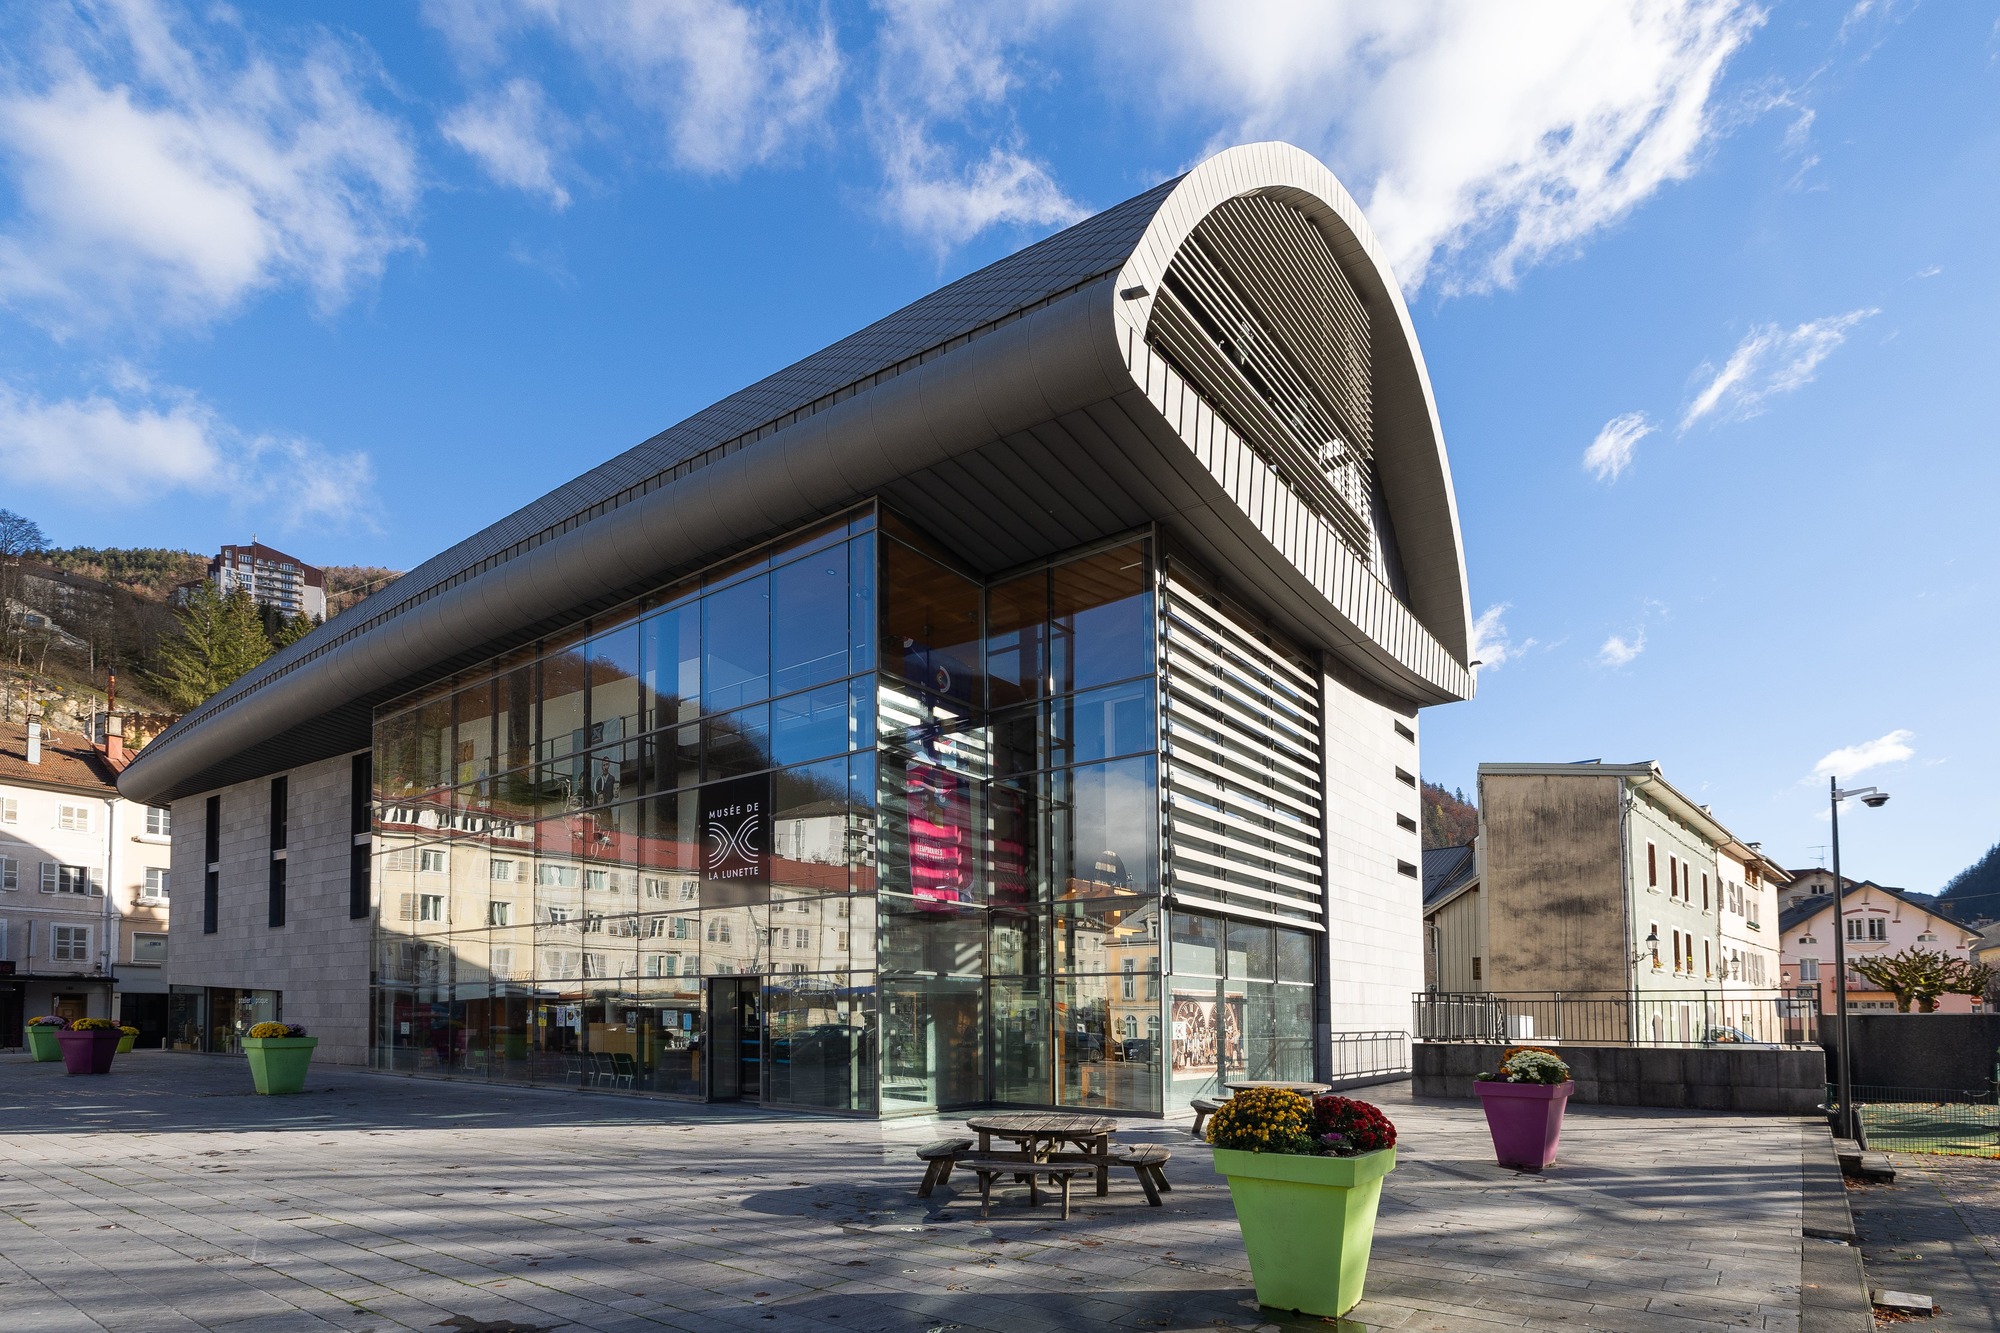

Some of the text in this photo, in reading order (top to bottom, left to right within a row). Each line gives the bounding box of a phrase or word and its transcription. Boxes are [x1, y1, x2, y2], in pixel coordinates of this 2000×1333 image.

[709, 802, 759, 819] MUSÉE DE
[708, 866, 759, 880] LA LUNETTE
